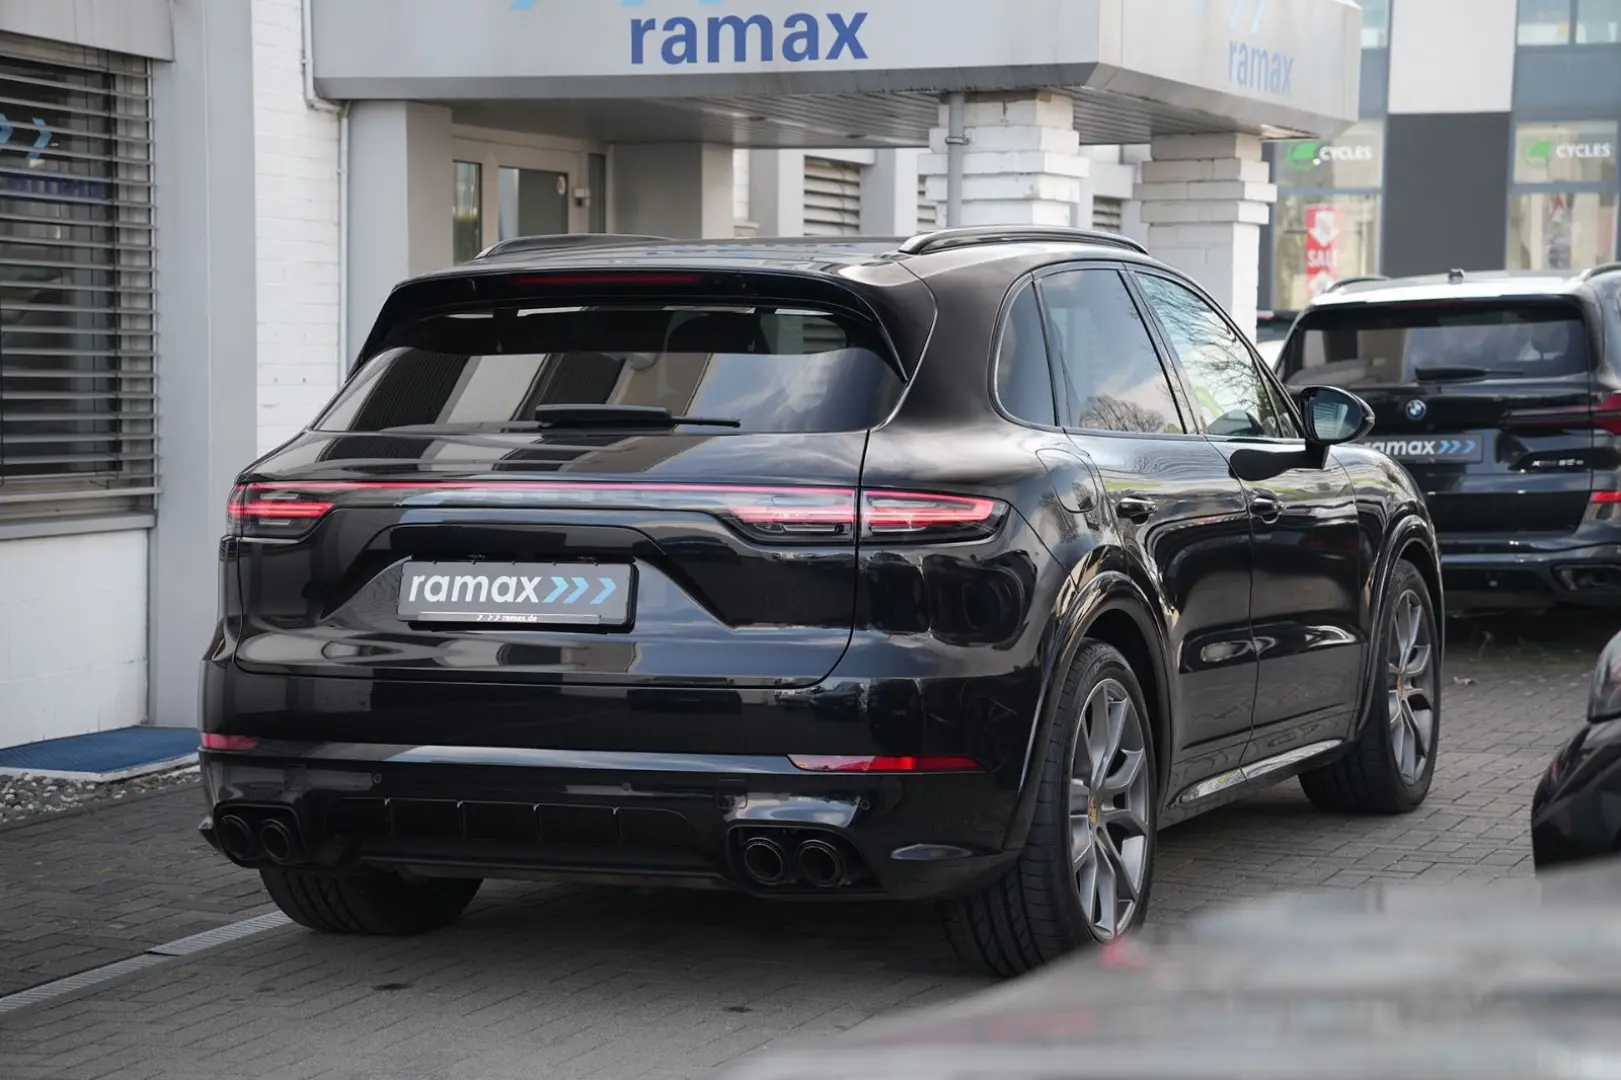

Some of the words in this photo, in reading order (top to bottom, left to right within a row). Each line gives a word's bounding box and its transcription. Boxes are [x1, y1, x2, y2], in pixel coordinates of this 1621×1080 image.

[631, 12, 868, 65] ramax
[1228, 40, 1294, 97] ramax
[1556, 142, 1611, 158] CYCLES
[409, 575, 542, 603] ramax
